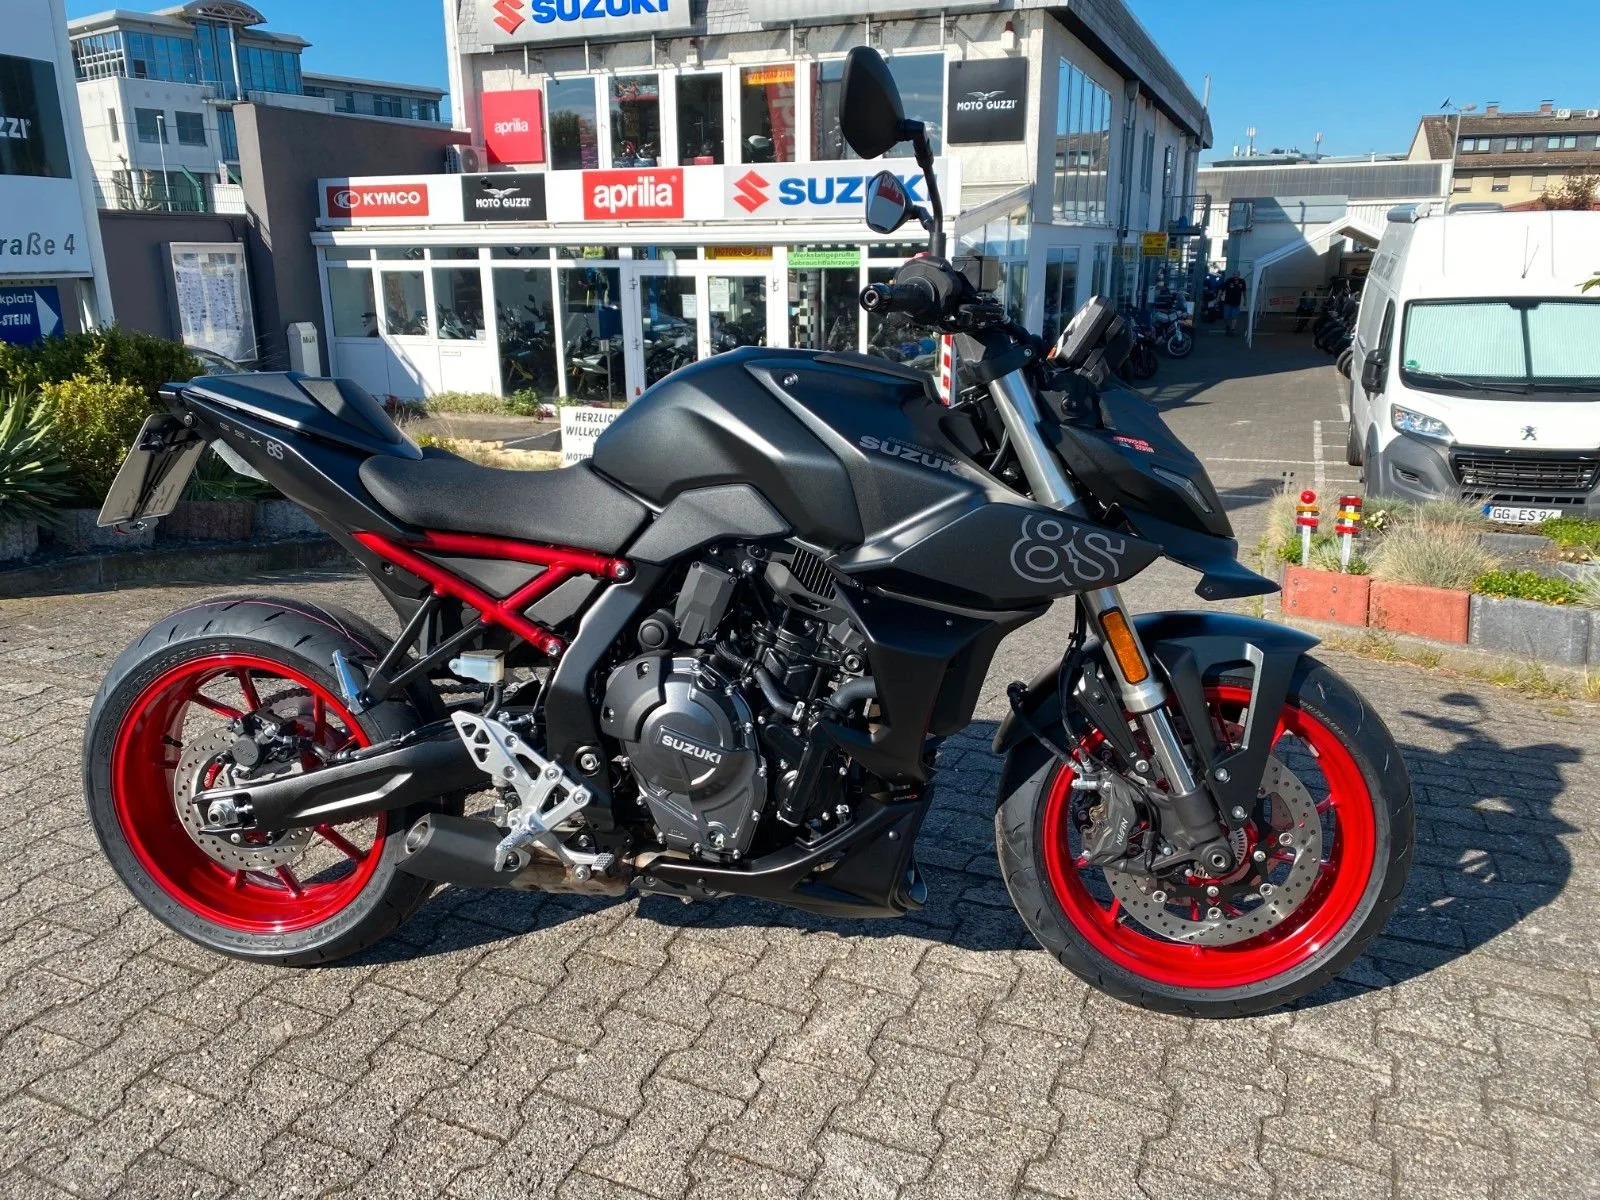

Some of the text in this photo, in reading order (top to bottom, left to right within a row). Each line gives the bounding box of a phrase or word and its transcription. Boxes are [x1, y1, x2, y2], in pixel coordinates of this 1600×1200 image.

[957, 100, 1015, 110] MOTO GUZZI
[494, 117, 529, 136] aprilia
[362, 191, 421, 206] KYMCO
[593, 175, 673, 214] aprilia
[778, 174, 938, 206] SUZK
[475, 197, 530, 208] MOTO GUZZI
[63, 233, 76, 255] 4
[575, 411, 618, 423] HERZLIC
[565, 425, 605, 438] WILLKO
[859, 435, 970, 481] SUZUK
[1493, 508, 1510, 520] GG
[1518, 509, 1536, 521] ES
[661, 735, 721, 764] SUZUKI
